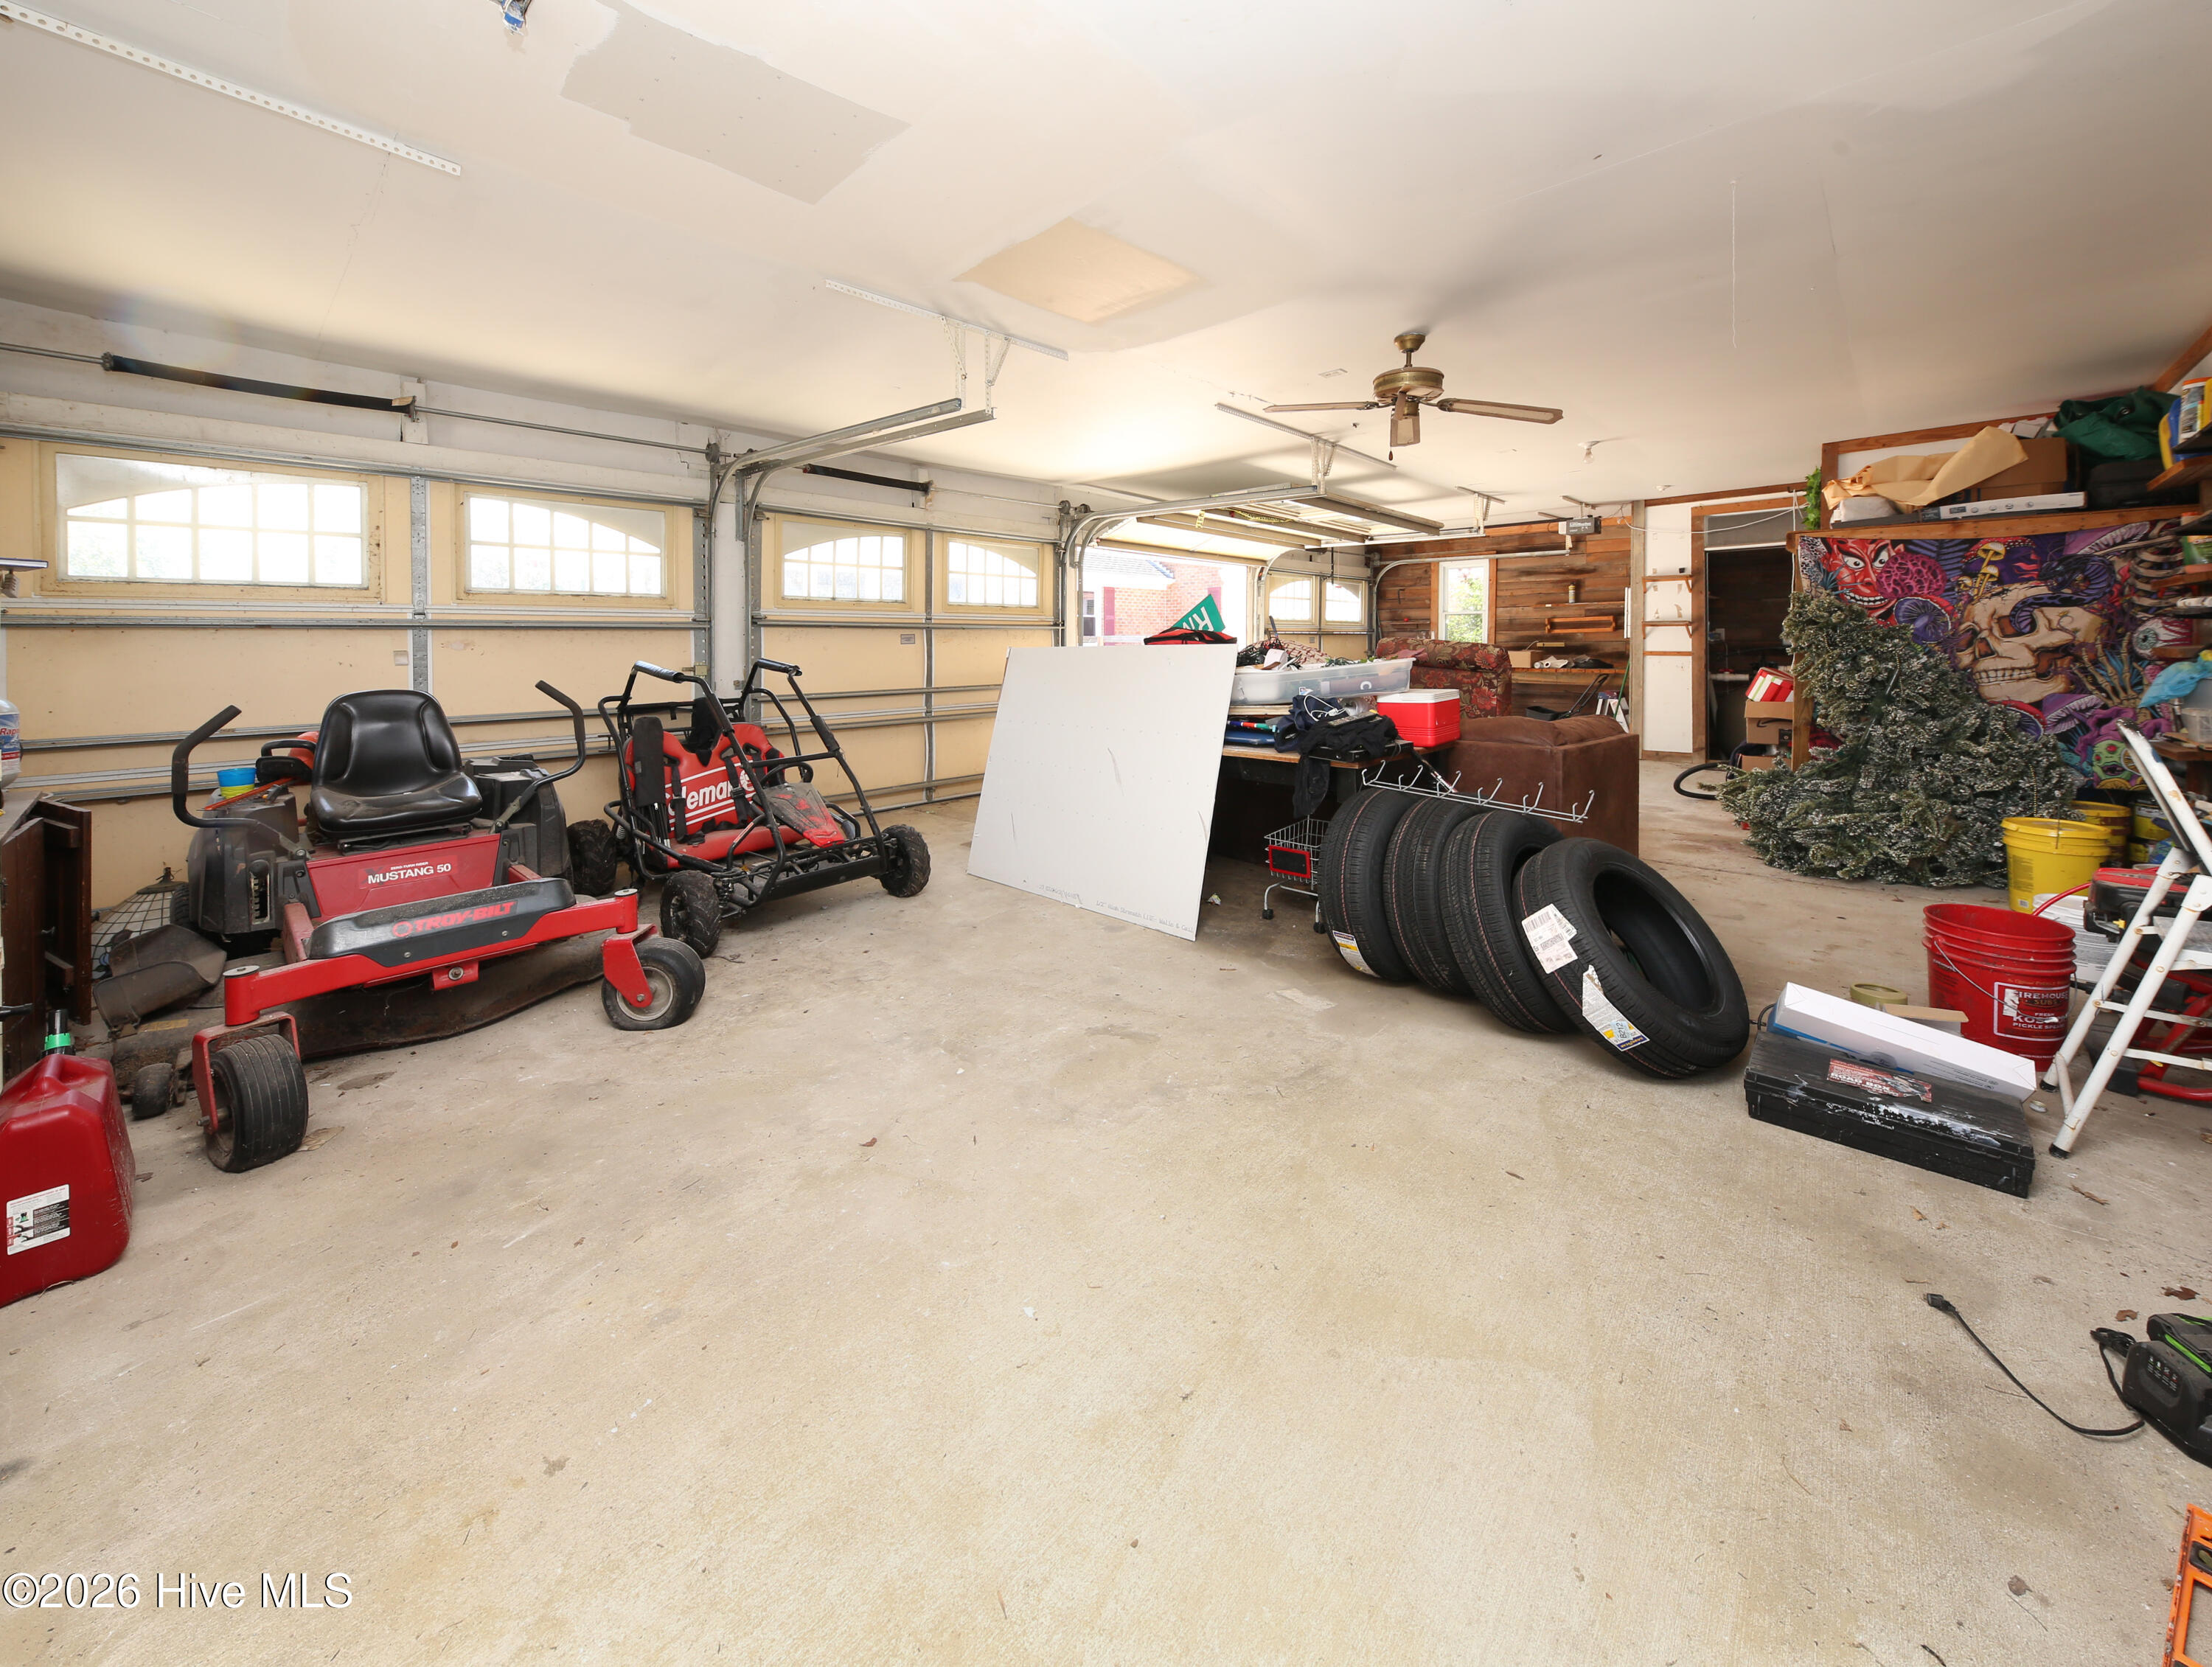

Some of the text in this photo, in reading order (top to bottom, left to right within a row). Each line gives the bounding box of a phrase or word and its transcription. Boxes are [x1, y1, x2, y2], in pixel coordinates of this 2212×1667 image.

[368, 866, 434, 884] MUSTANG
[437, 863, 452, 874] 50
[414, 902, 515, 932] TROY-BILT
[1865, 1081, 1890, 1090] BOX
